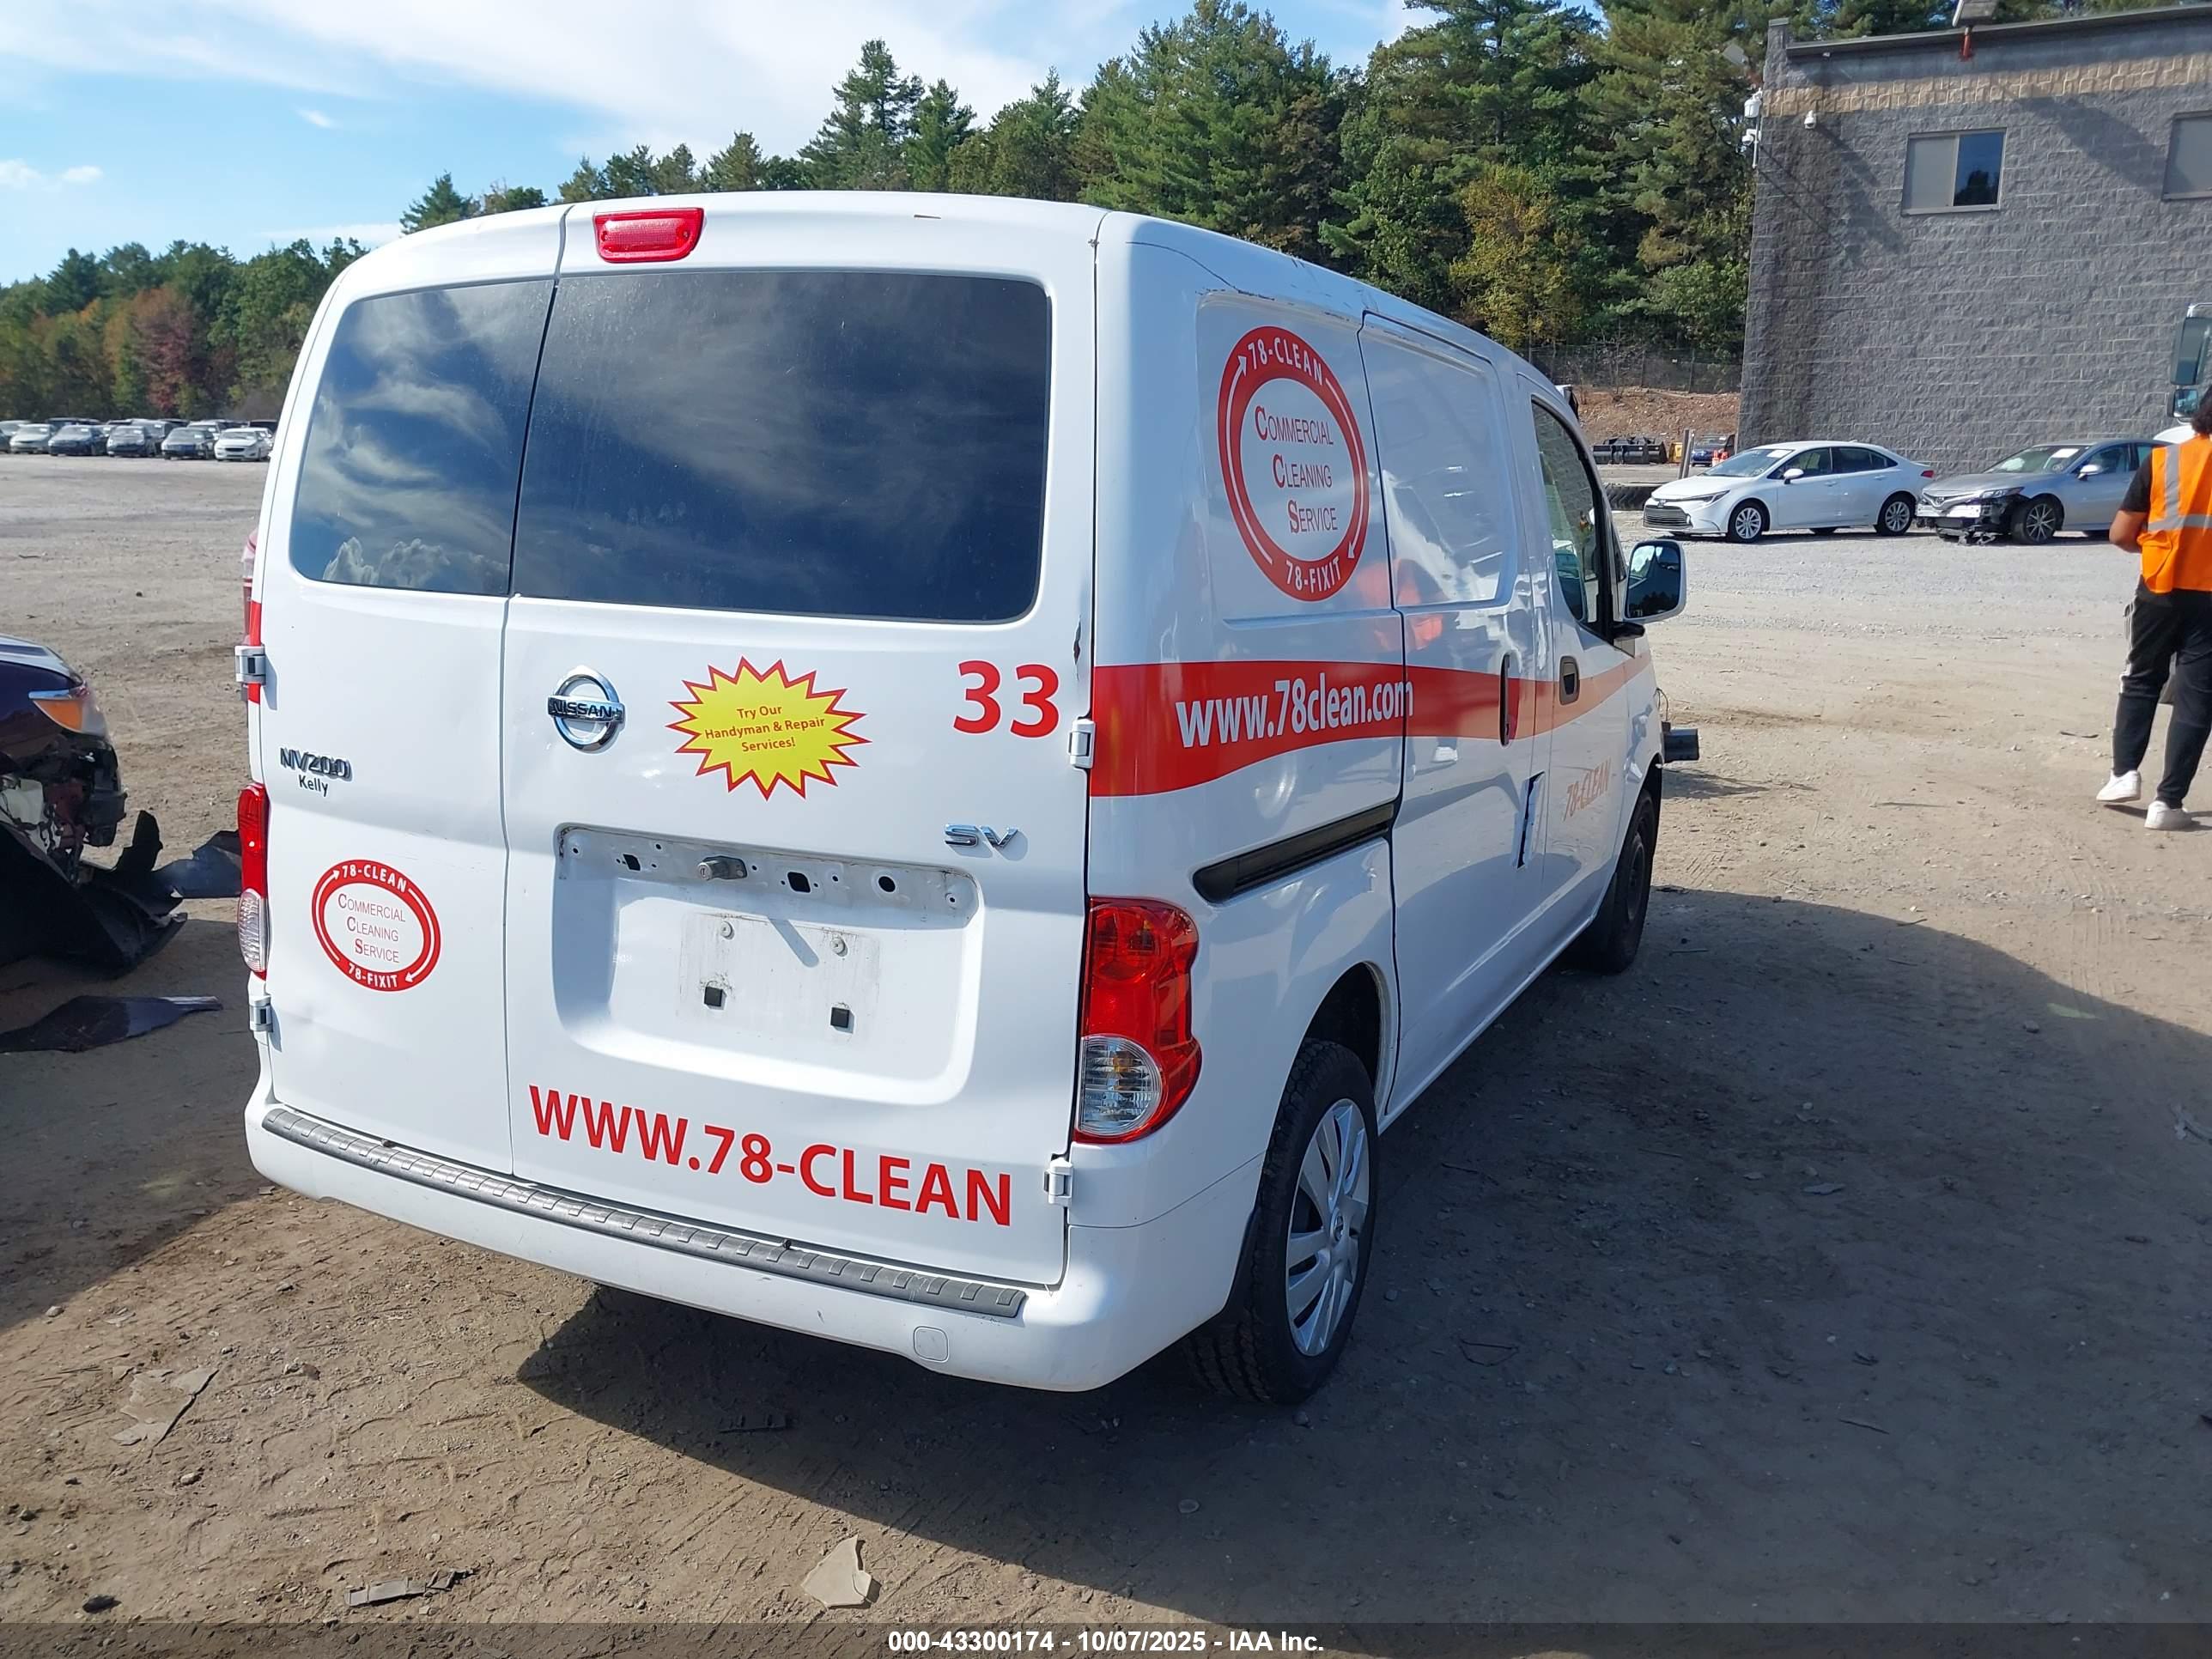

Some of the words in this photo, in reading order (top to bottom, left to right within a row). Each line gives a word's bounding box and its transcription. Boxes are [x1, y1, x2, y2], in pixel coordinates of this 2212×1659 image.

[1248, 337, 1322, 386] 78-CLEAN
[1286, 558, 1340, 592] 78-FIXIT
[552, 699, 612, 718] NISSAN
[737, 708, 757, 720] Try
[759, 704, 782, 717] Our
[953, 660, 1059, 738] 33
[1176, 672, 1413, 748] www.78clean.com
[705, 725, 770, 738] Handyman
[773, 721, 782, 732] &
[785, 717, 825, 732] Repair
[741, 737, 795, 751] Services!
[280, 747, 350, 781] NV200
[298, 775, 328, 797] Kelly
[1563, 757, 1611, 821] 78-CLEAN
[945, 823, 1018, 848] SV
[342, 864, 407, 893] 78-CLEAN
[347, 963, 398, 988] 78-FIXIT
[529, 1085, 1012, 1226] WWW.78-CLEAN
